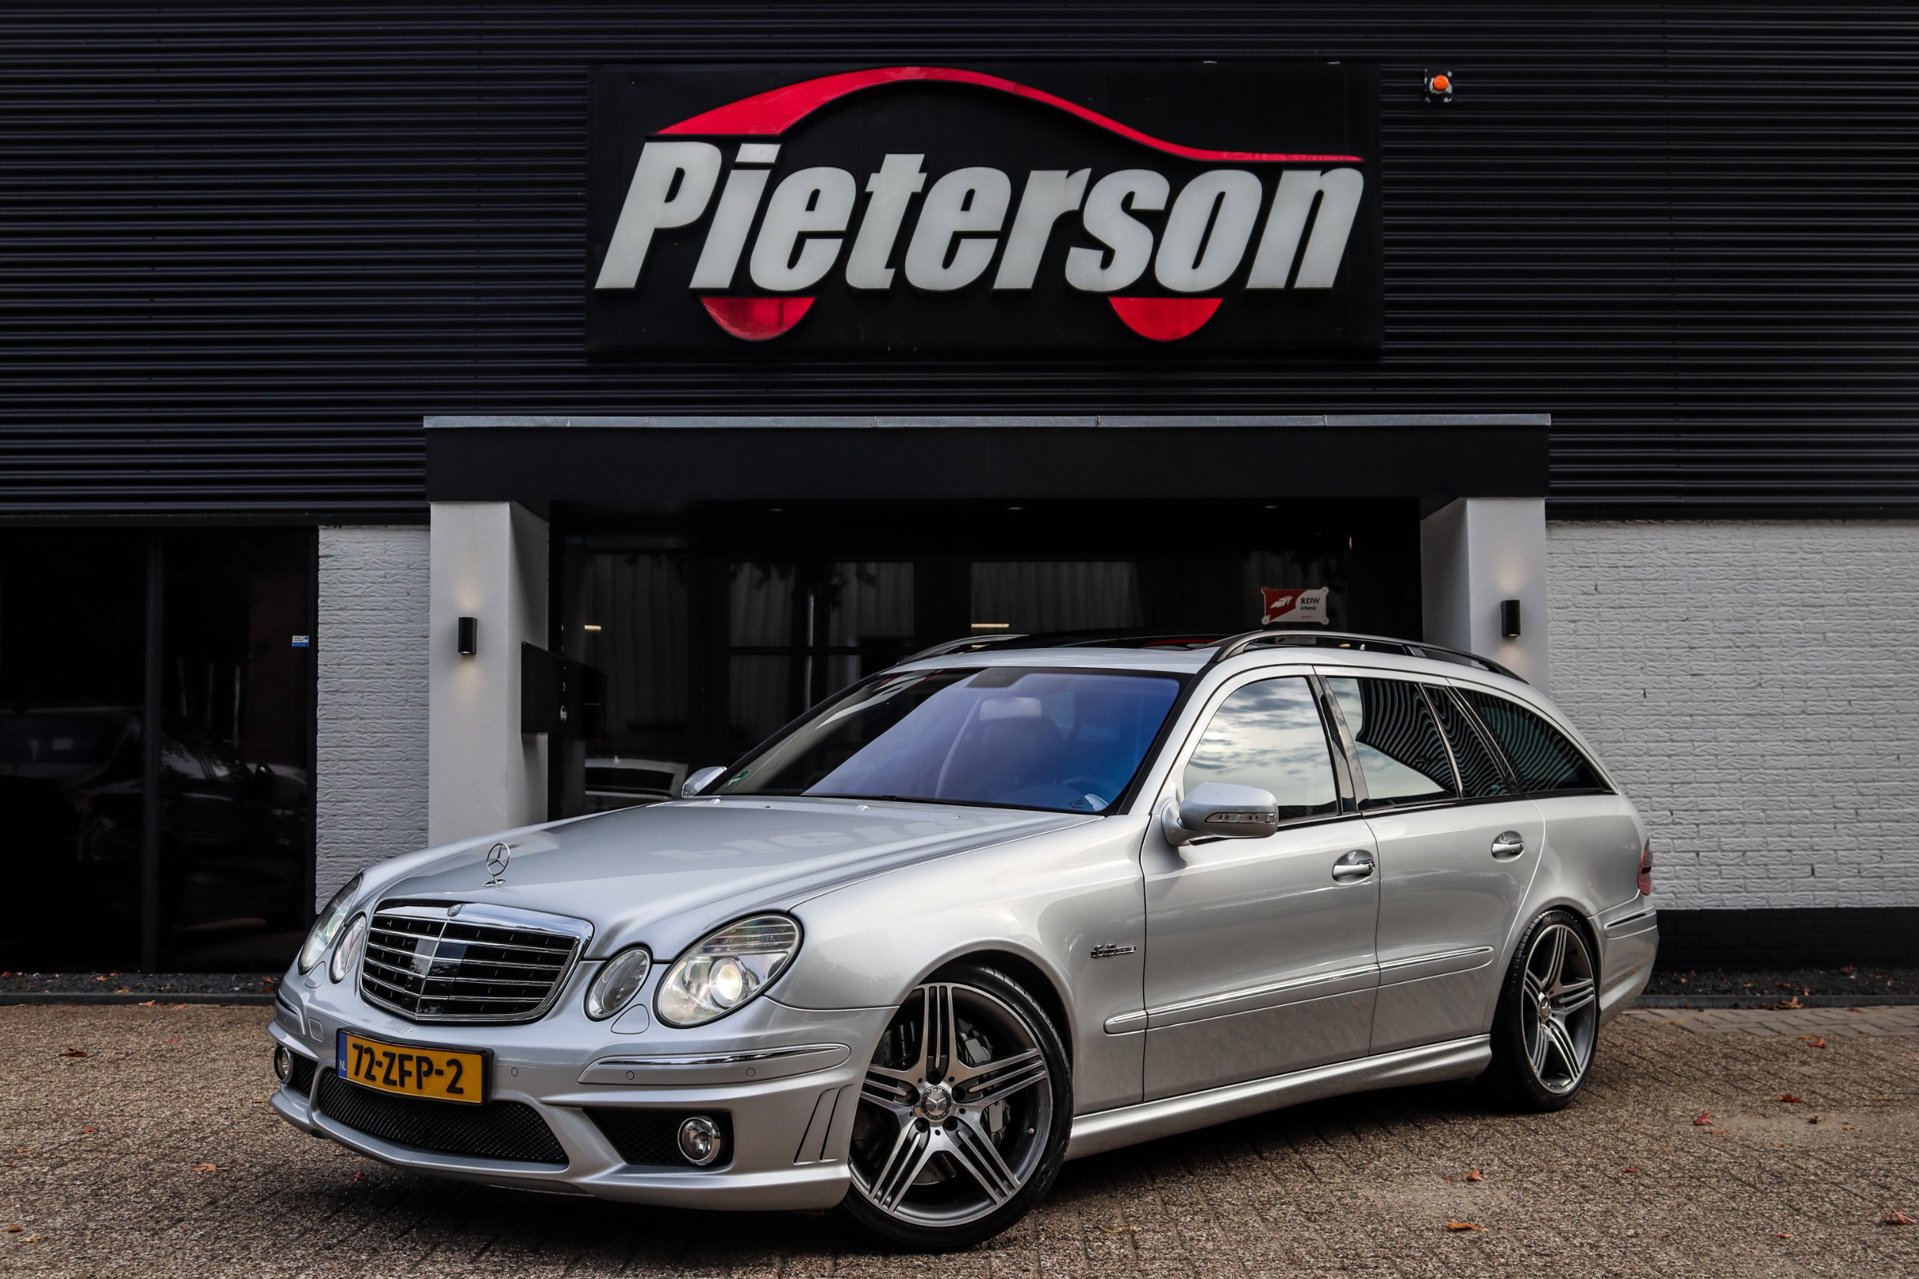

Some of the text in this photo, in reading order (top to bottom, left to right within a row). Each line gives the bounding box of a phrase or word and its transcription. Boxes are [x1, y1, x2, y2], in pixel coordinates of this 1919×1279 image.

[594, 142, 1365, 292] Pieterson
[338, 1059, 347, 1072] NL
[352, 1043, 464, 1094] 72-ZFP-2
